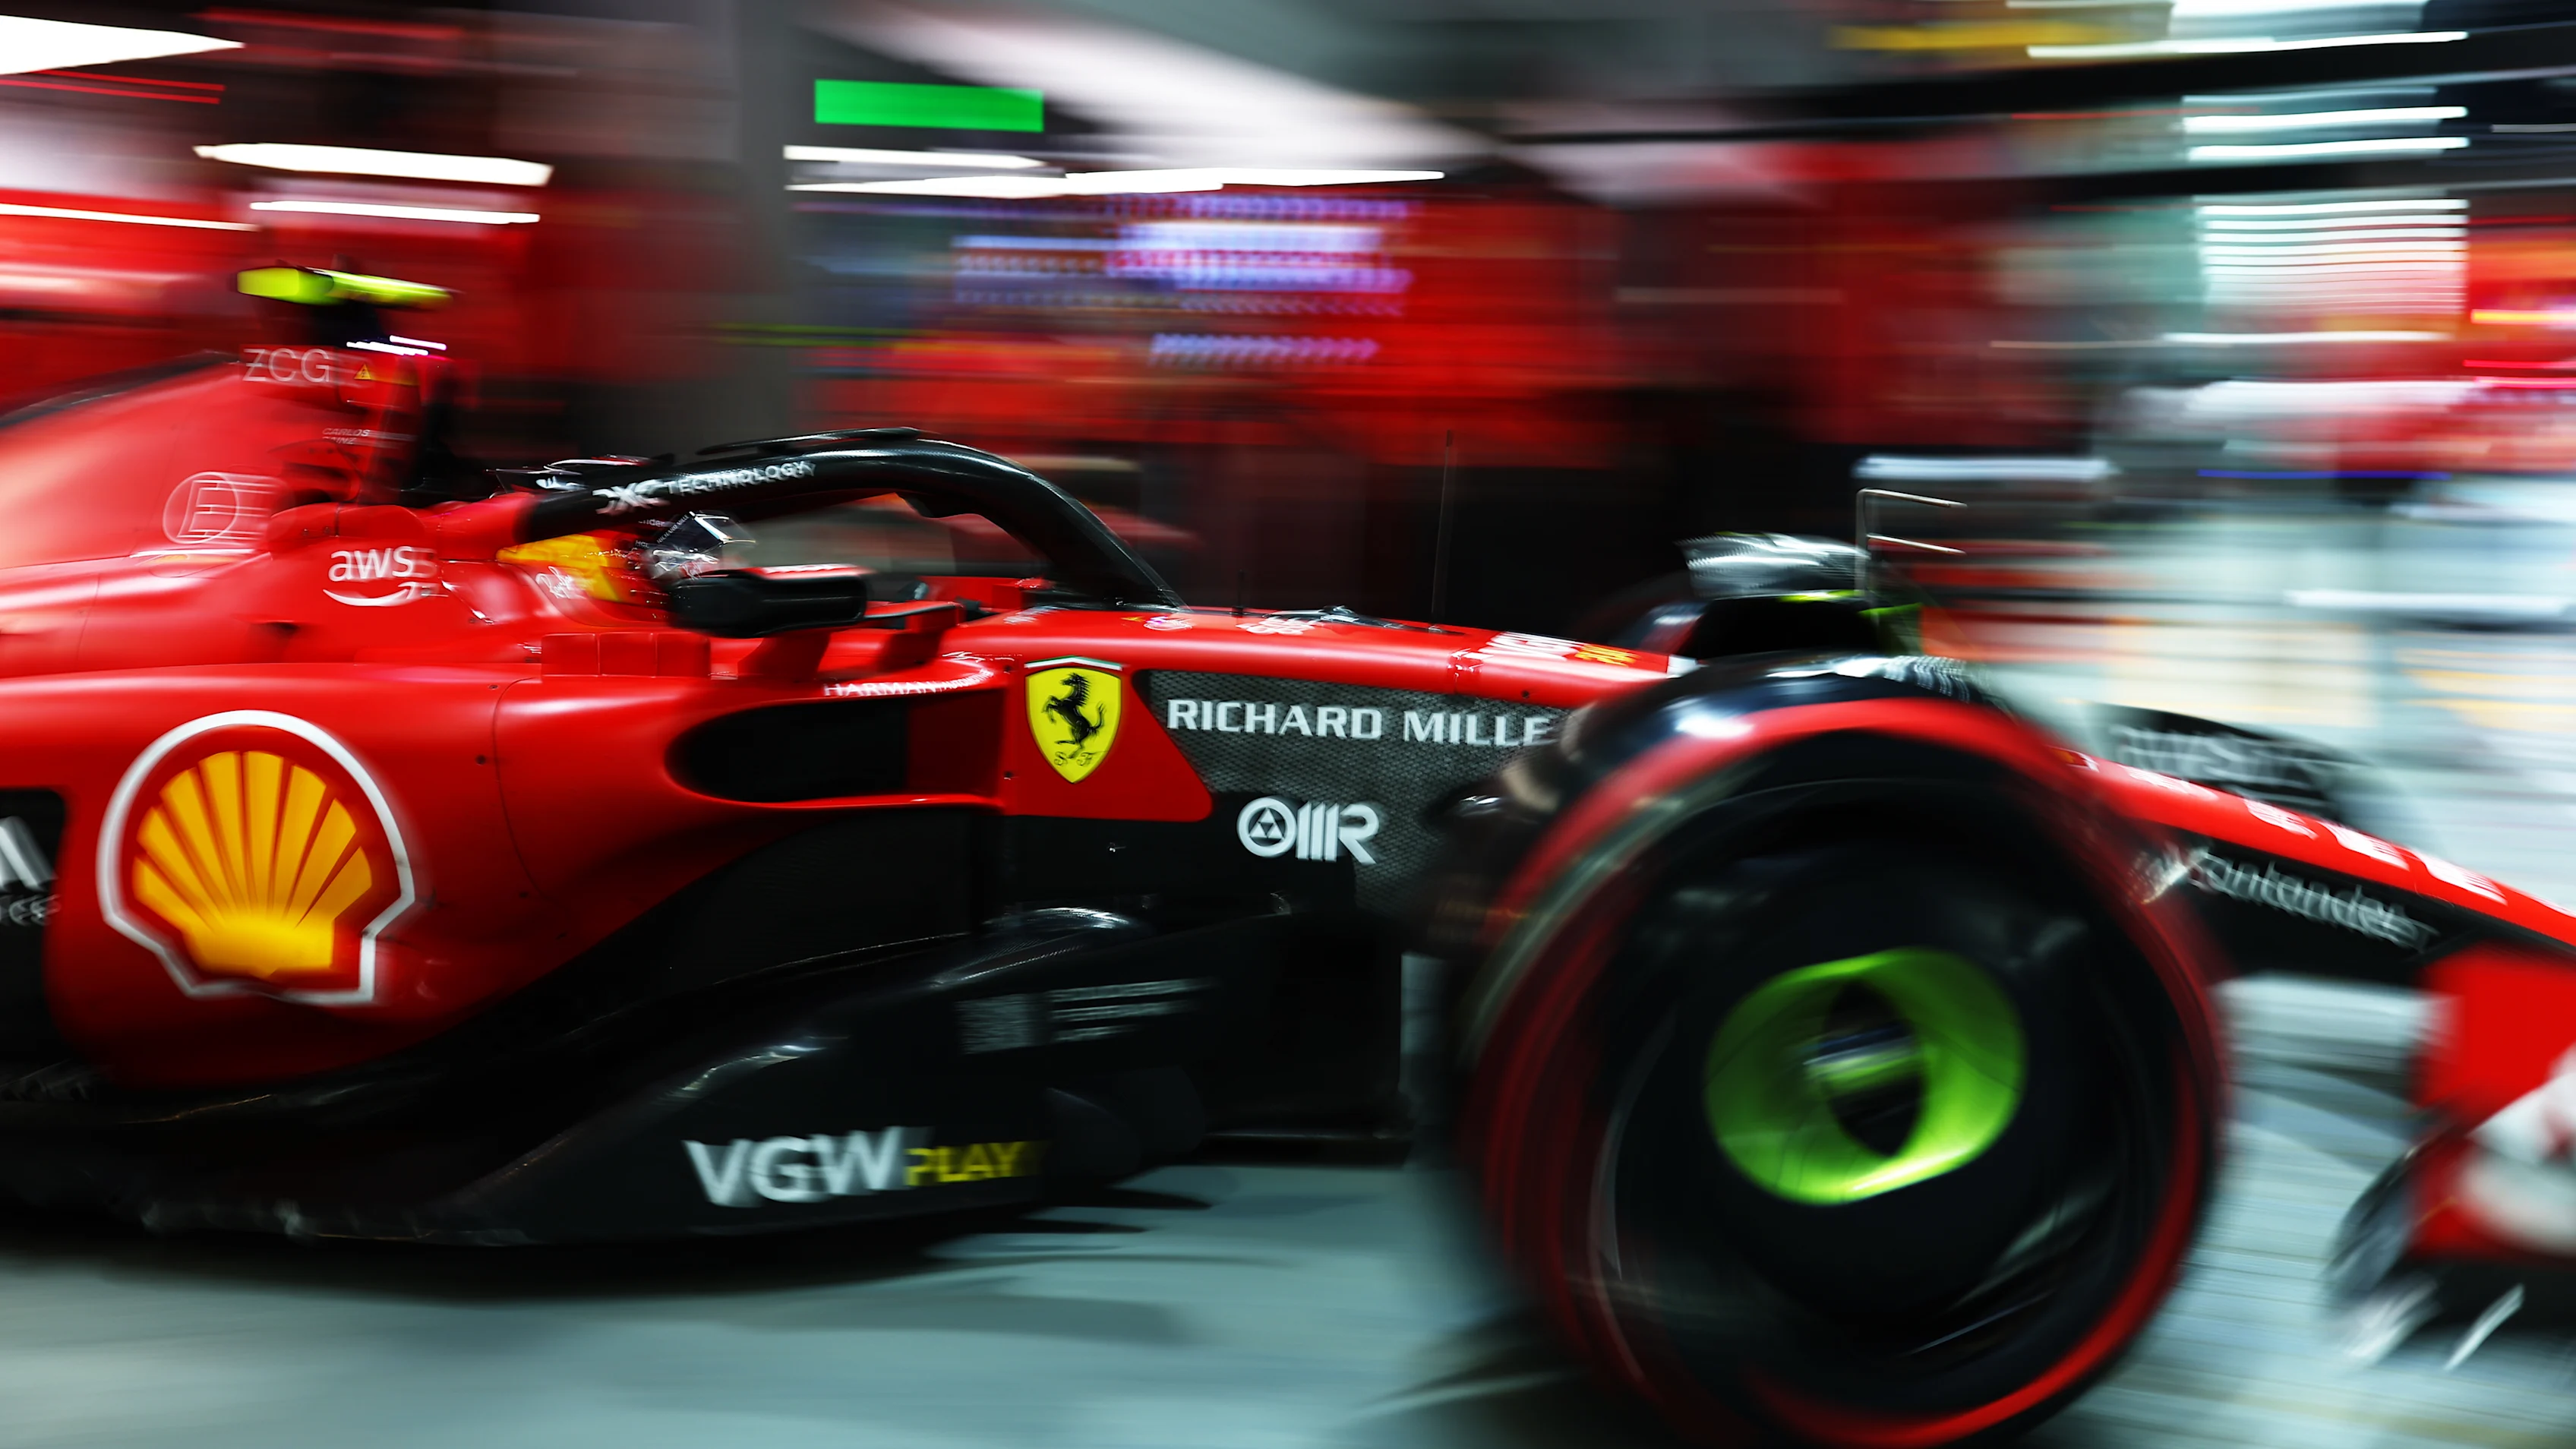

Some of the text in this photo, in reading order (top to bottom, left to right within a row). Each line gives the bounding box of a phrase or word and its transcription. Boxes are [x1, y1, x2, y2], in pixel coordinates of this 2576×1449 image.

[322, 428, 371, 437] CARLOS
[592, 479, 662, 515] DXC
[666, 460, 816, 494] TECHNOLOGY
[328, 546, 415, 582] aws
[824, 681, 937, 697] HARMAN
[1167, 699, 1555, 746] RICHARD MILLE
[682, 1126, 1037, 1208] VGW PLAY
